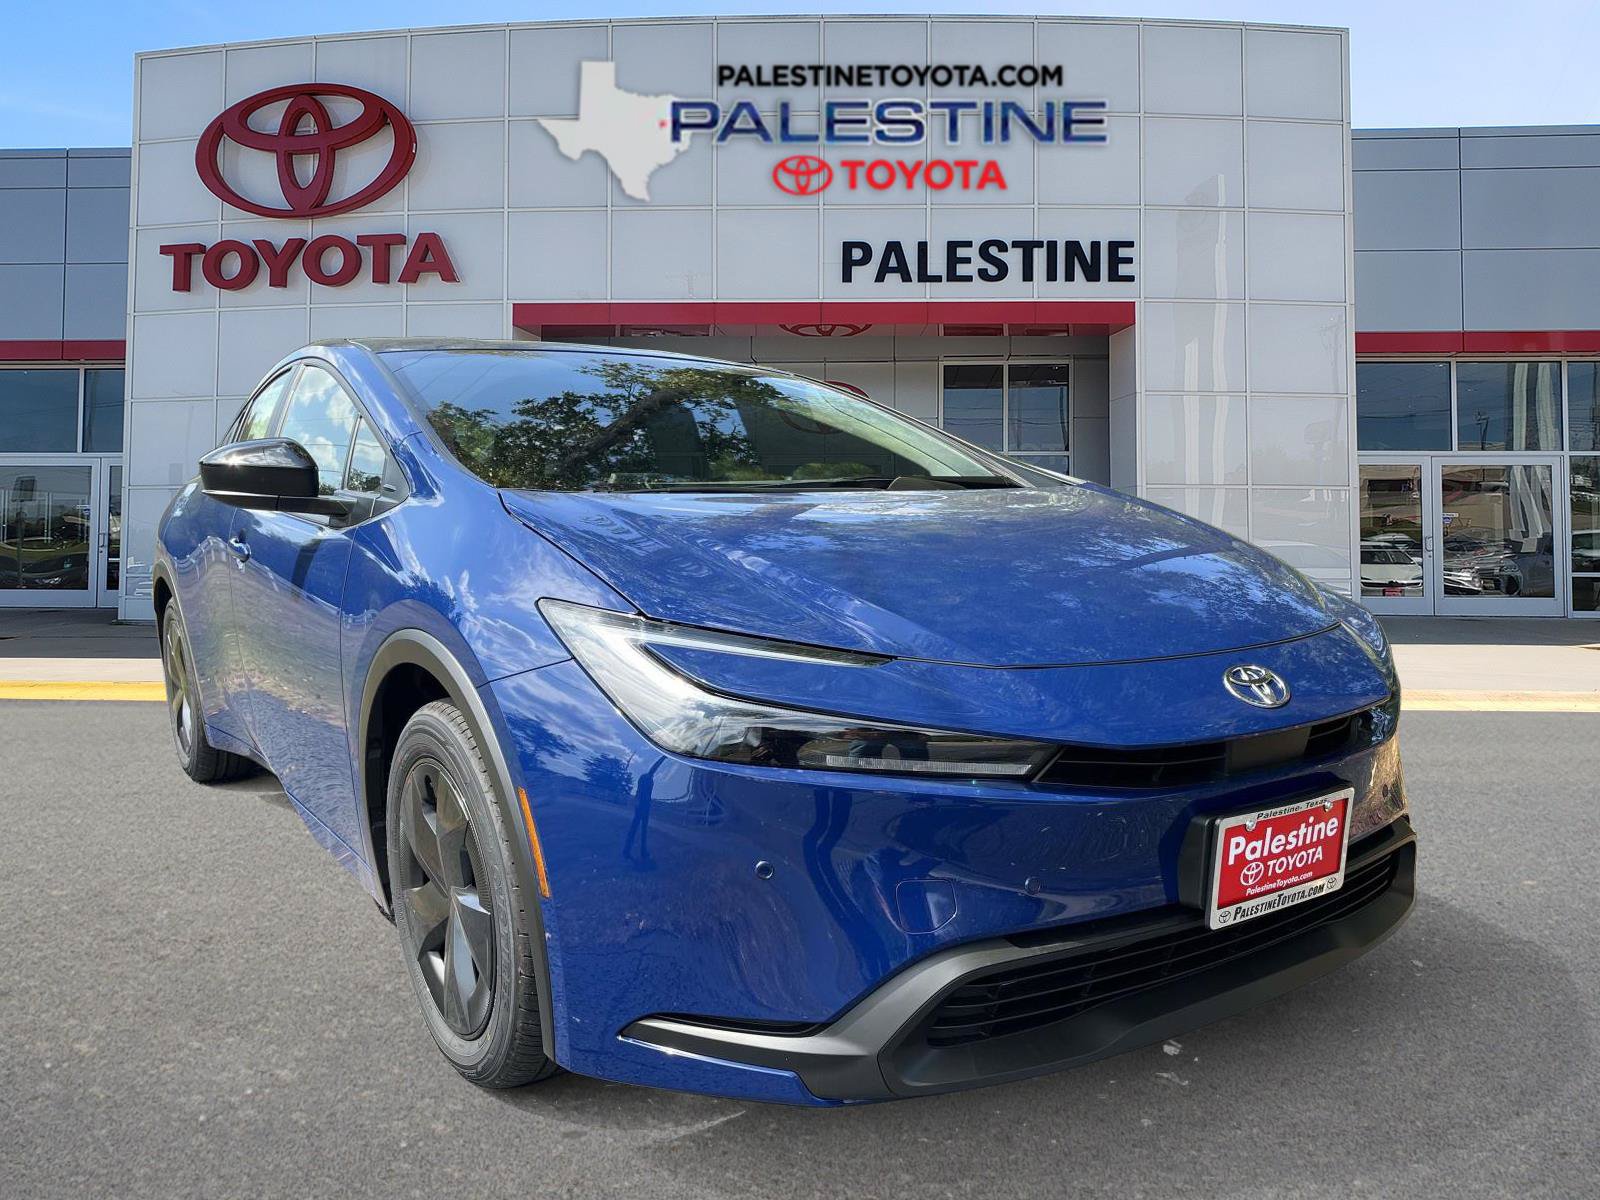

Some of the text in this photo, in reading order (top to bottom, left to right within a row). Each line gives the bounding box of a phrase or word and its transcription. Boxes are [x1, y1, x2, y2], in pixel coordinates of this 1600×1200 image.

[159, 232, 460, 292] TOYOTA
[842, 240, 1135, 283] PALESTINE
[1228, 815, 1338, 866] Palestine
[1267, 846, 1323, 876] TOYOTA
[1246, 871, 1313, 896] PalestineToyota.com
